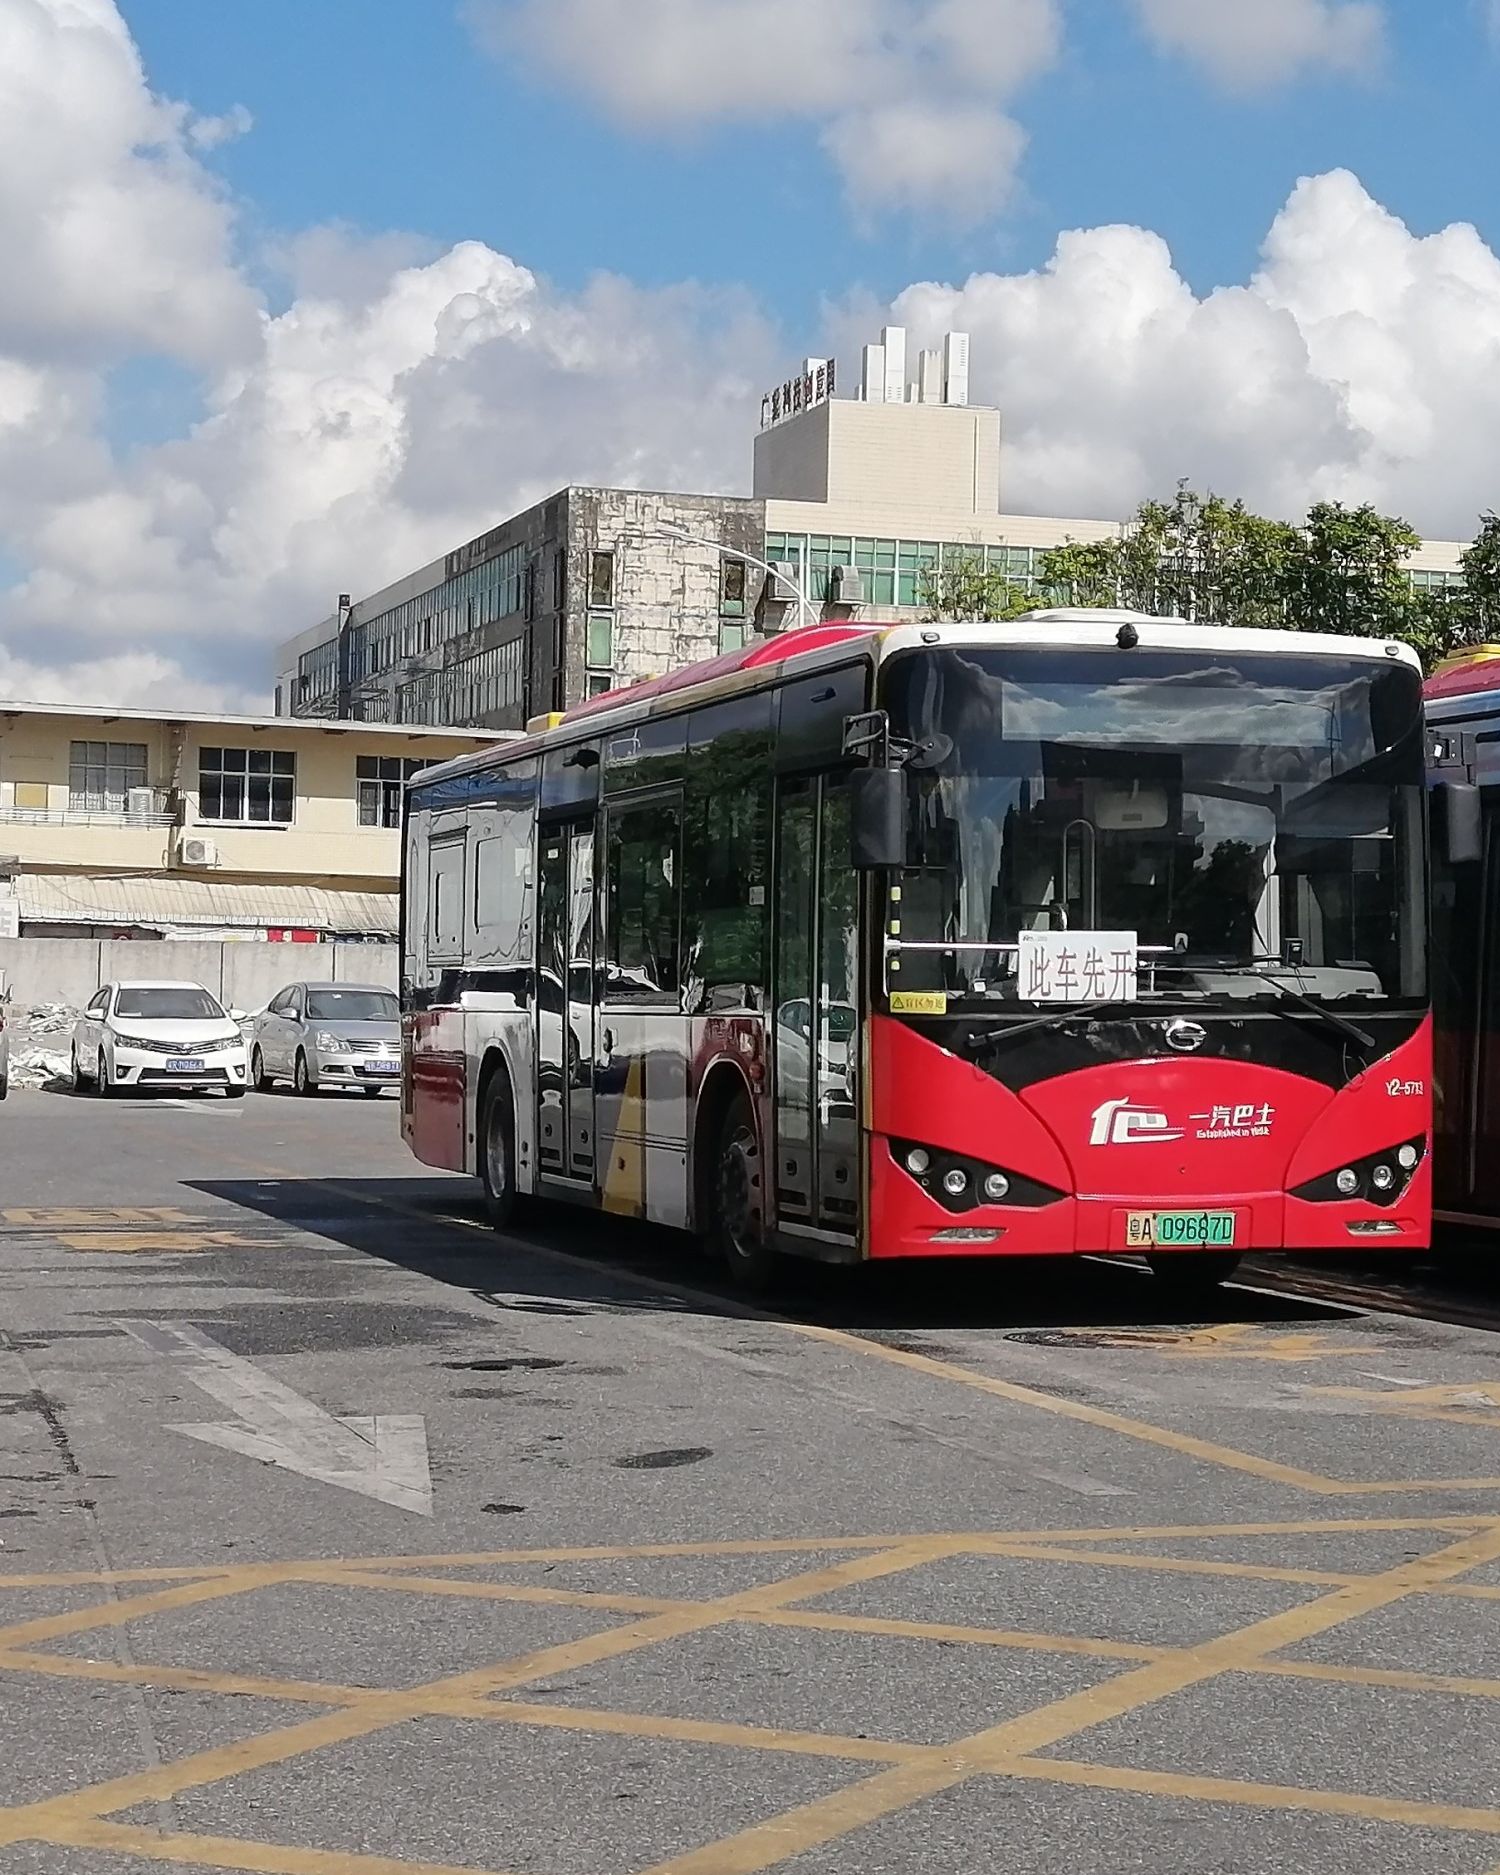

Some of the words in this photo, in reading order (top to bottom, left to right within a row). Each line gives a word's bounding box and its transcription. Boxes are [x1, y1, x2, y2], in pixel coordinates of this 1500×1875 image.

[1027, 946, 1135, 1001] 此车先开
[1188, 1102, 1277, 1128] 一汽巴士
